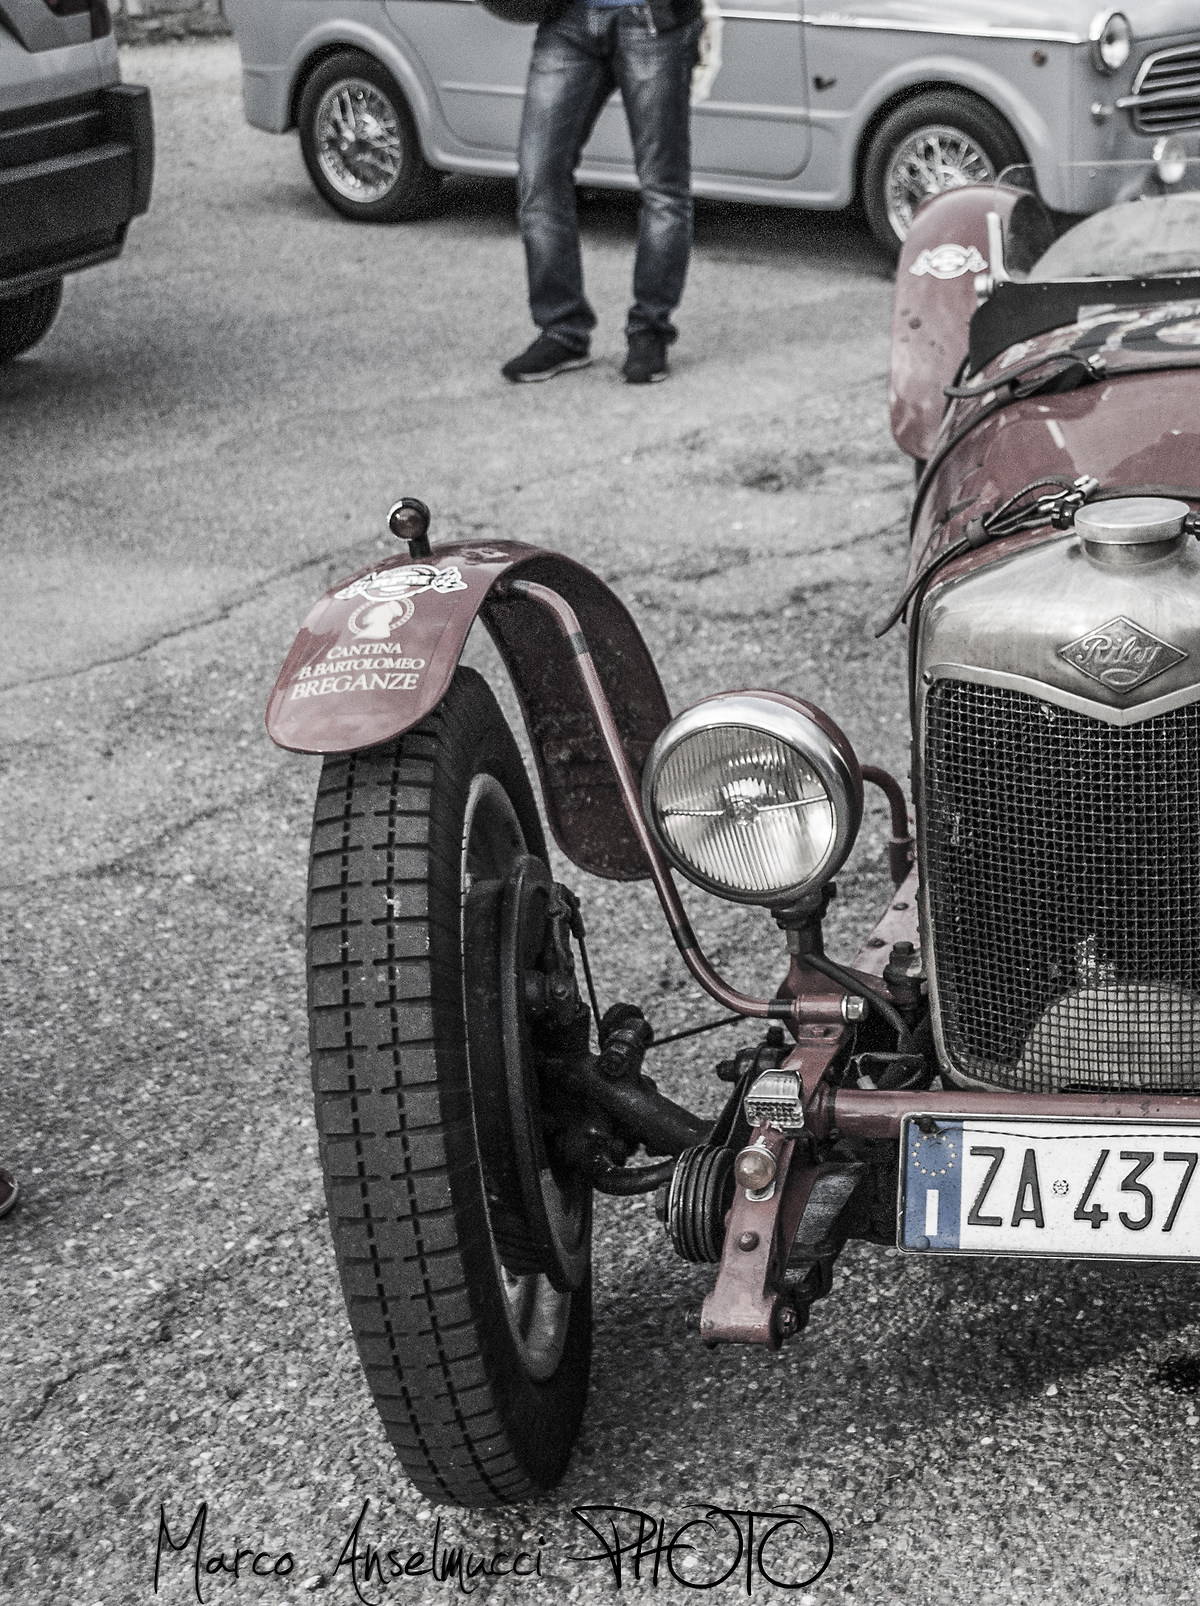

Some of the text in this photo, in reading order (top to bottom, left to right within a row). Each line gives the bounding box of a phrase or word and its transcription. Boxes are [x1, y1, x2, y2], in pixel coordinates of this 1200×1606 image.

[327, 642, 402, 659] CANTINA
[1075, 634, 1162, 686] Riley
[290, 673, 418, 700] BREGANZE
[967, 1145, 1045, 1229] ZA
